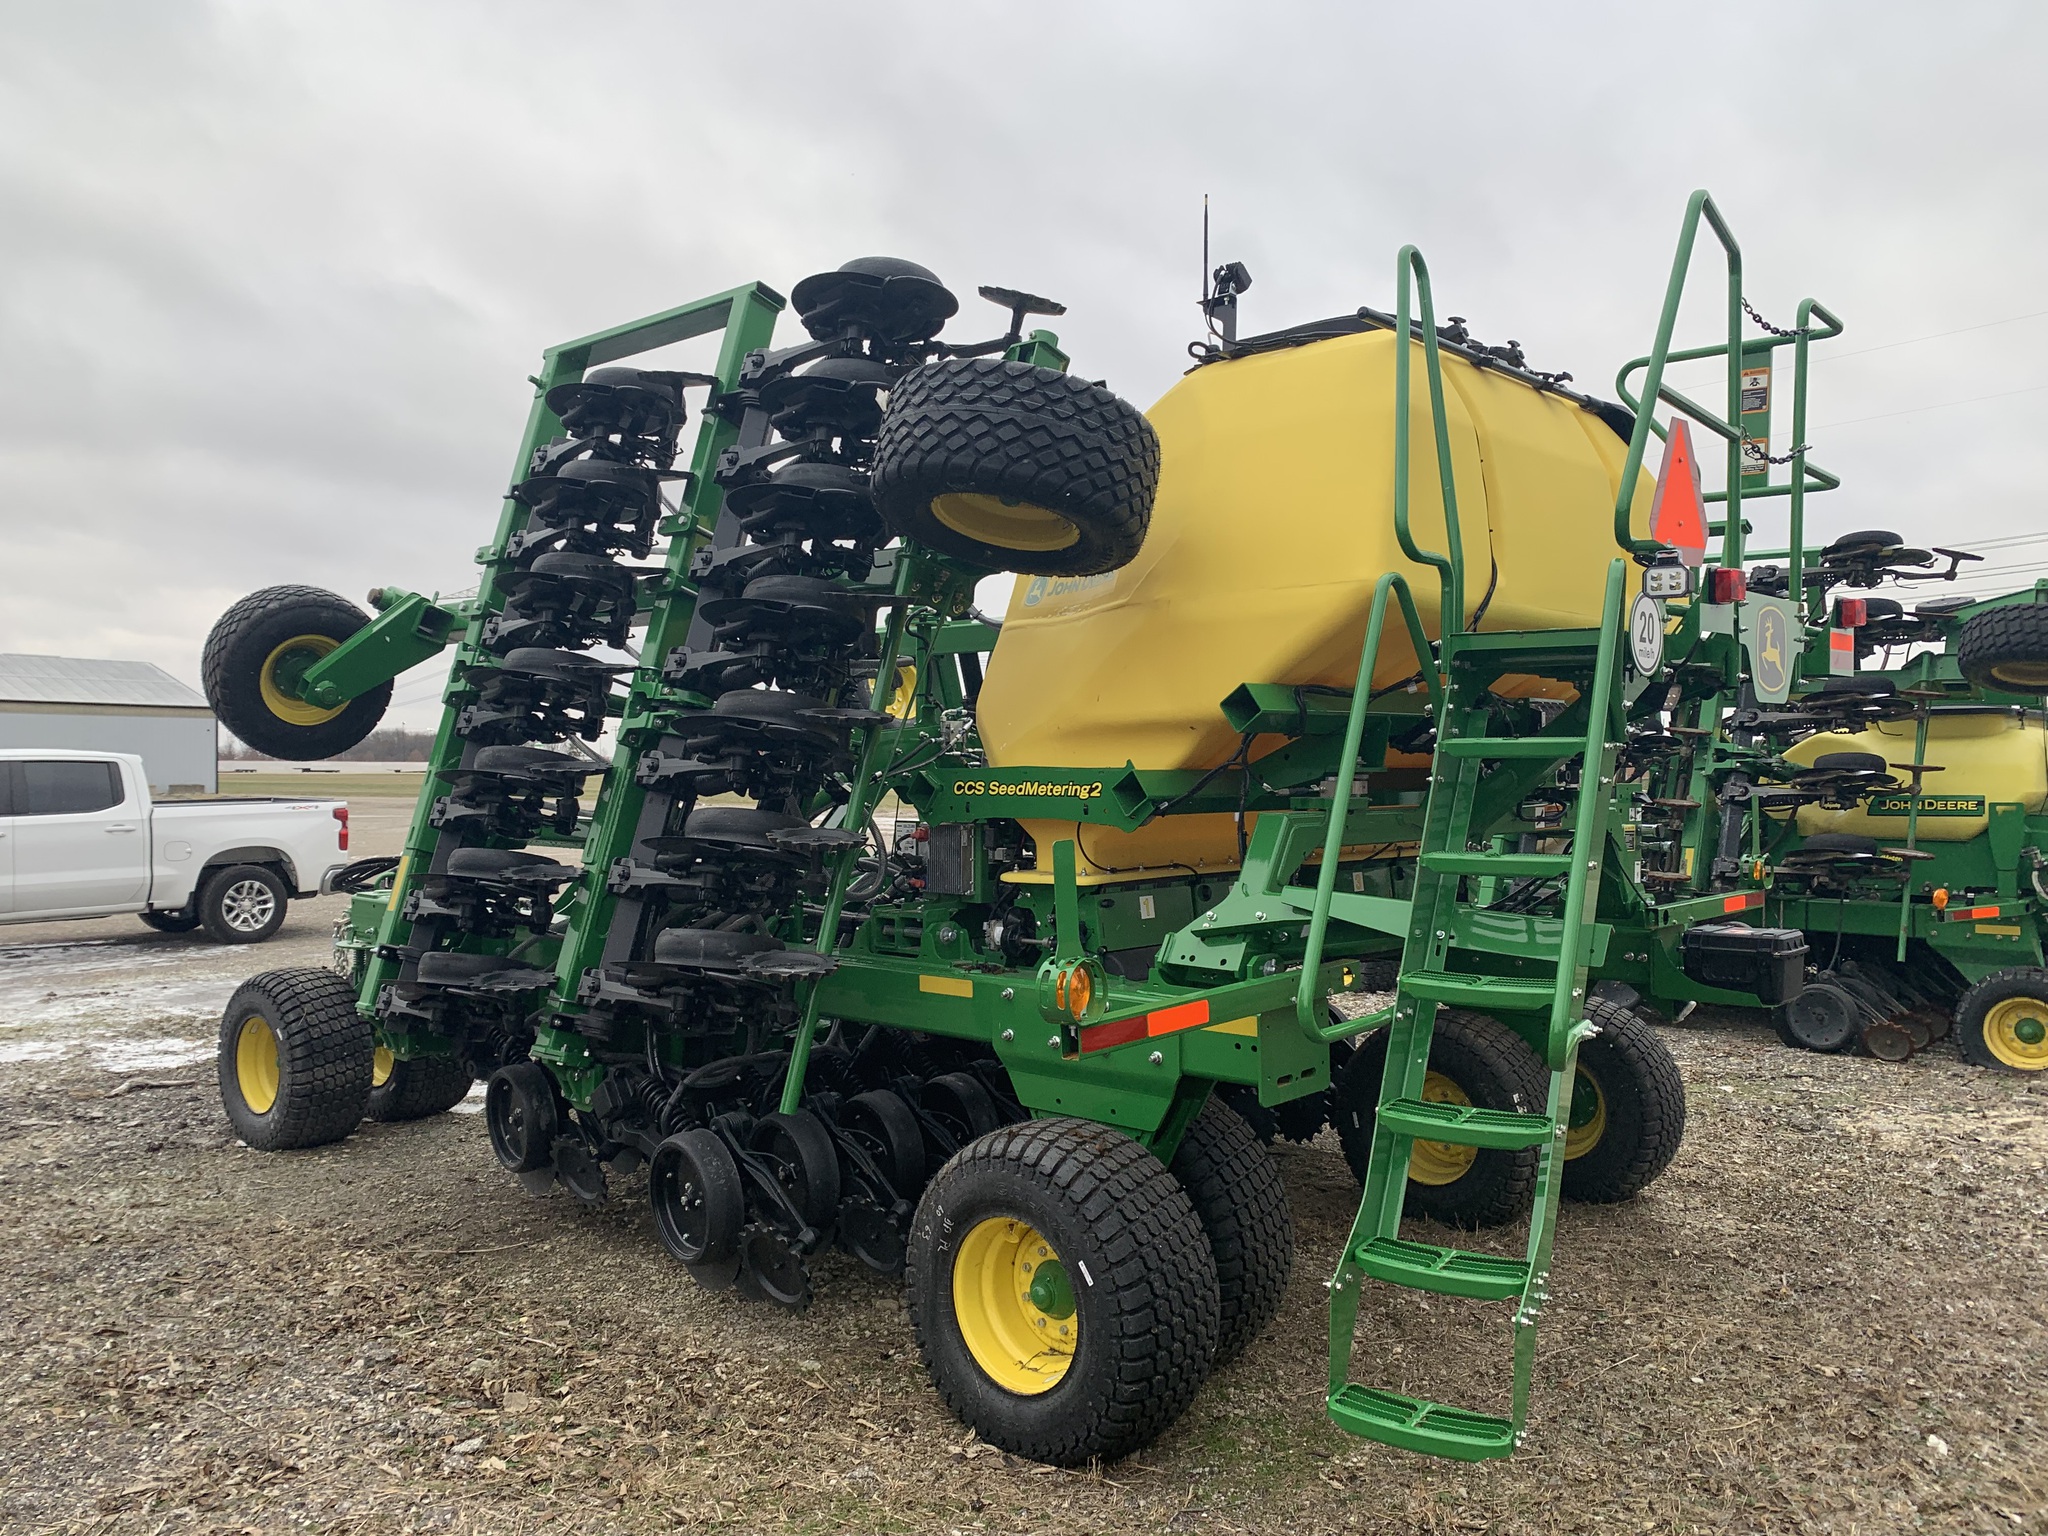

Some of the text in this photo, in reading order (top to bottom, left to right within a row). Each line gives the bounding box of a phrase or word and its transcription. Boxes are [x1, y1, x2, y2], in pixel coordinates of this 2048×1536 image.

[1639, 610, 1655, 645] 20
[953, 780, 1103, 800] CCS SeedMetering2
[1924, 799, 1978, 811] DEERE
[1142, 897, 1151, 917] 1
